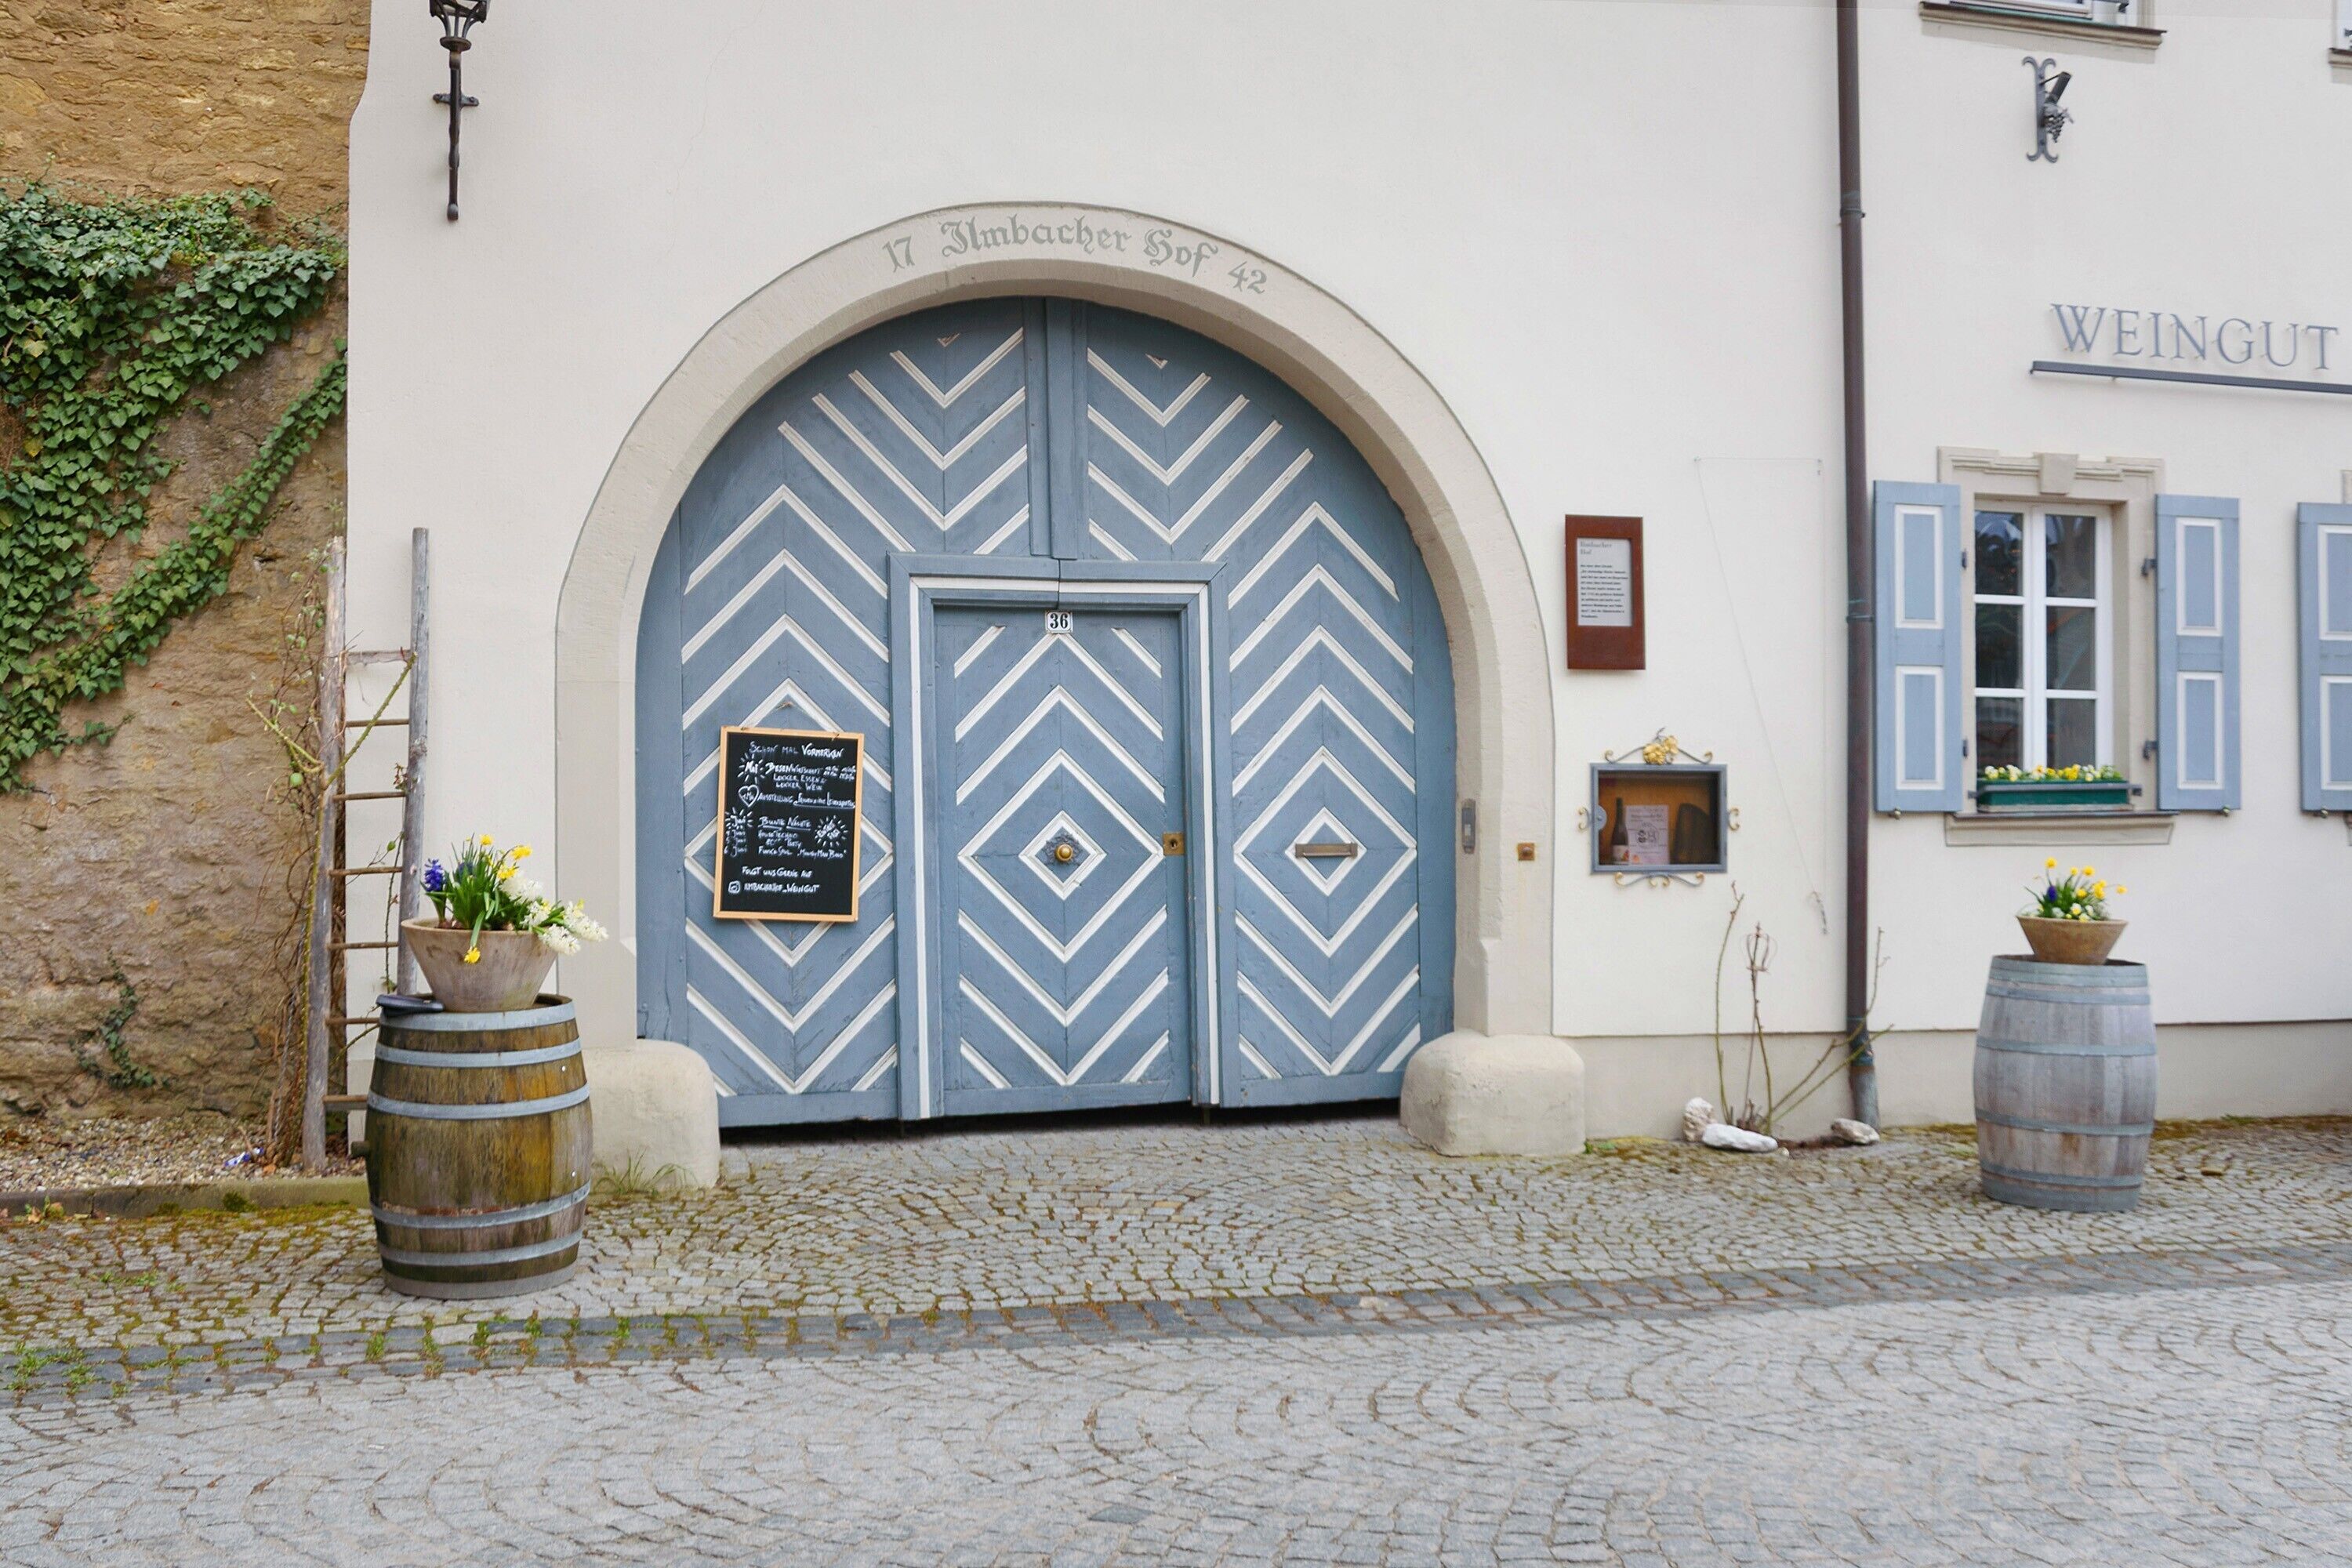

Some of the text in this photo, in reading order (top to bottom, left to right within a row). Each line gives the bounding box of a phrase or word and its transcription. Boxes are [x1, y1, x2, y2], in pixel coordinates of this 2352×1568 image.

[882, 215, 1268, 294] 17 Ilmbacher Hof 42
[2051, 303, 2339, 370] WEINGUT
[1050, 612, 1069, 629] 36
